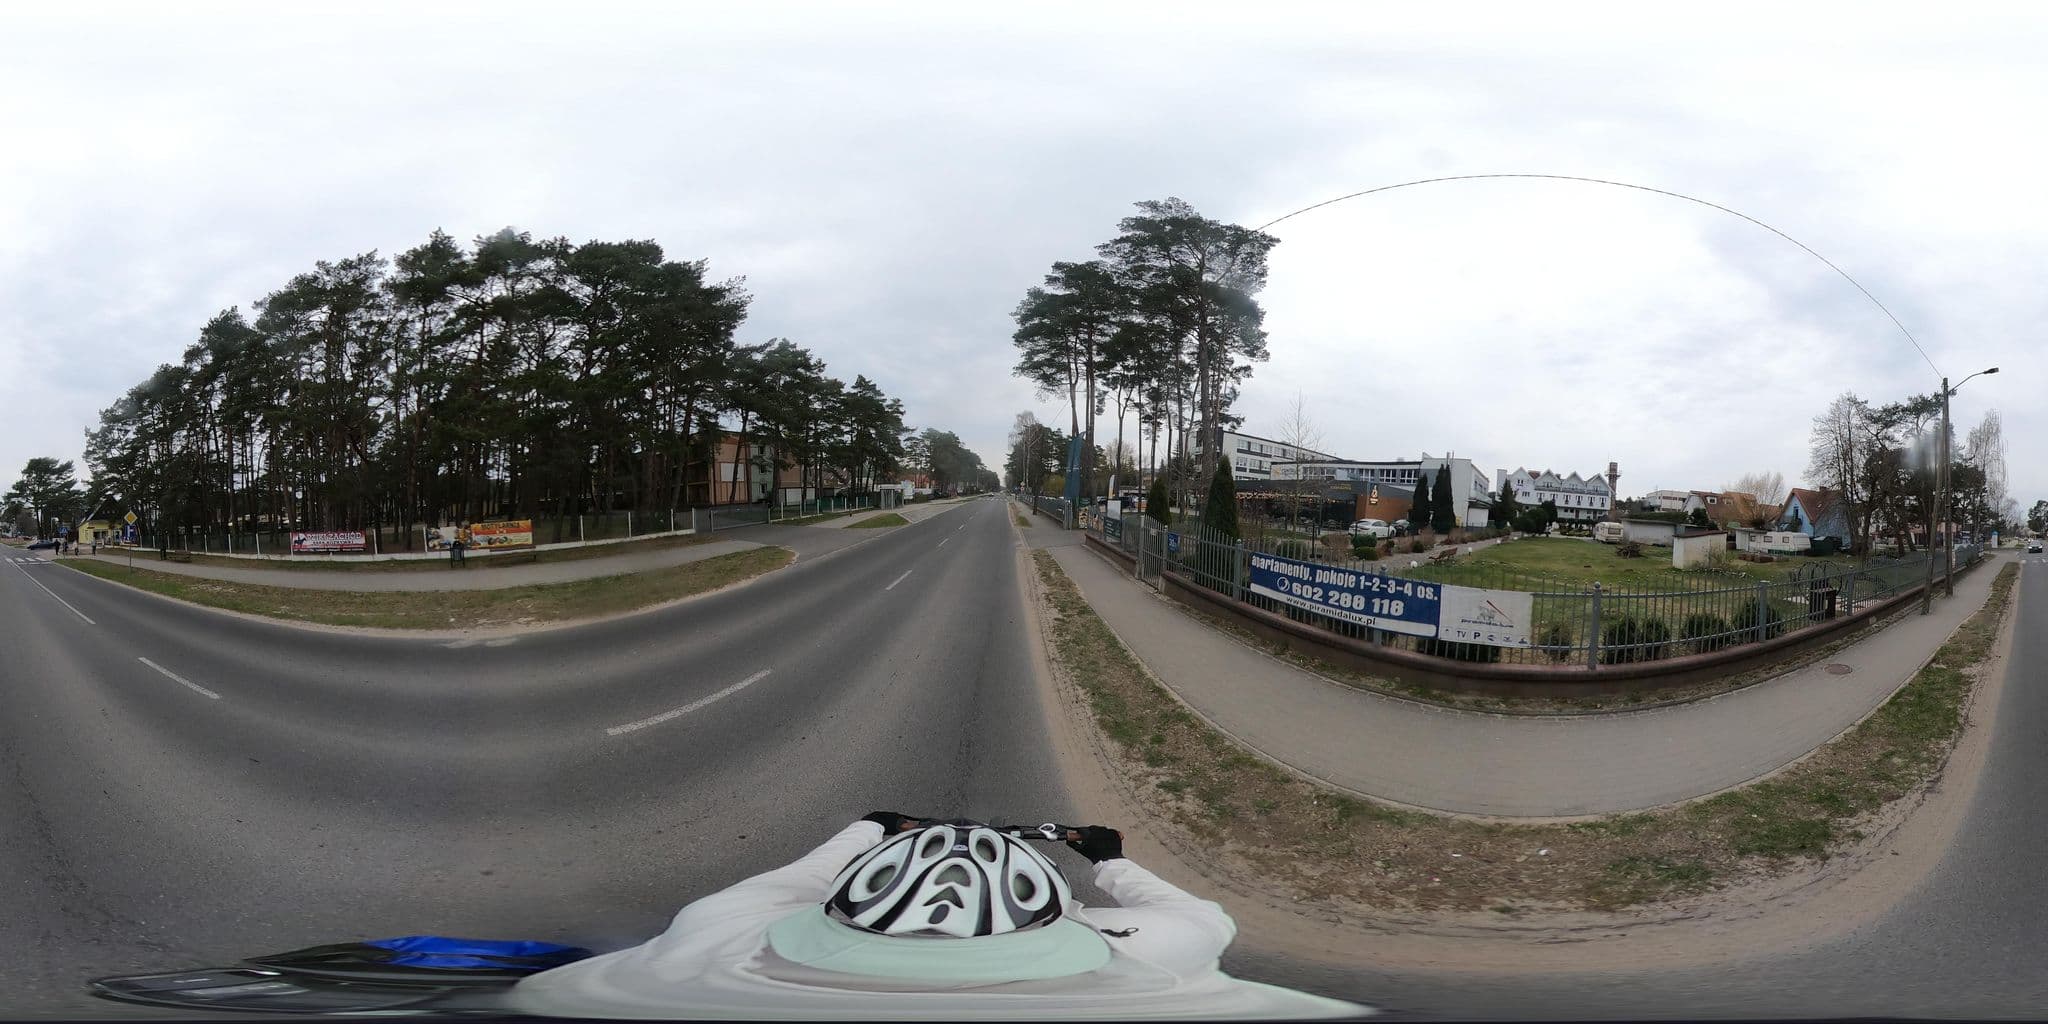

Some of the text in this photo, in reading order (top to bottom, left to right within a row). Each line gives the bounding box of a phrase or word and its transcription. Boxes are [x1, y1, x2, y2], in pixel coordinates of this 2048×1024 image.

[1252, 556, 1438, 600] apartamenty, pokoje 1-2-3-4 os.
[1286, 597, 1376, 625] www.piramidalux.pl
[1292, 582, 1404, 616] 602 288 118
[1456, 630, 1466, 638] TV
